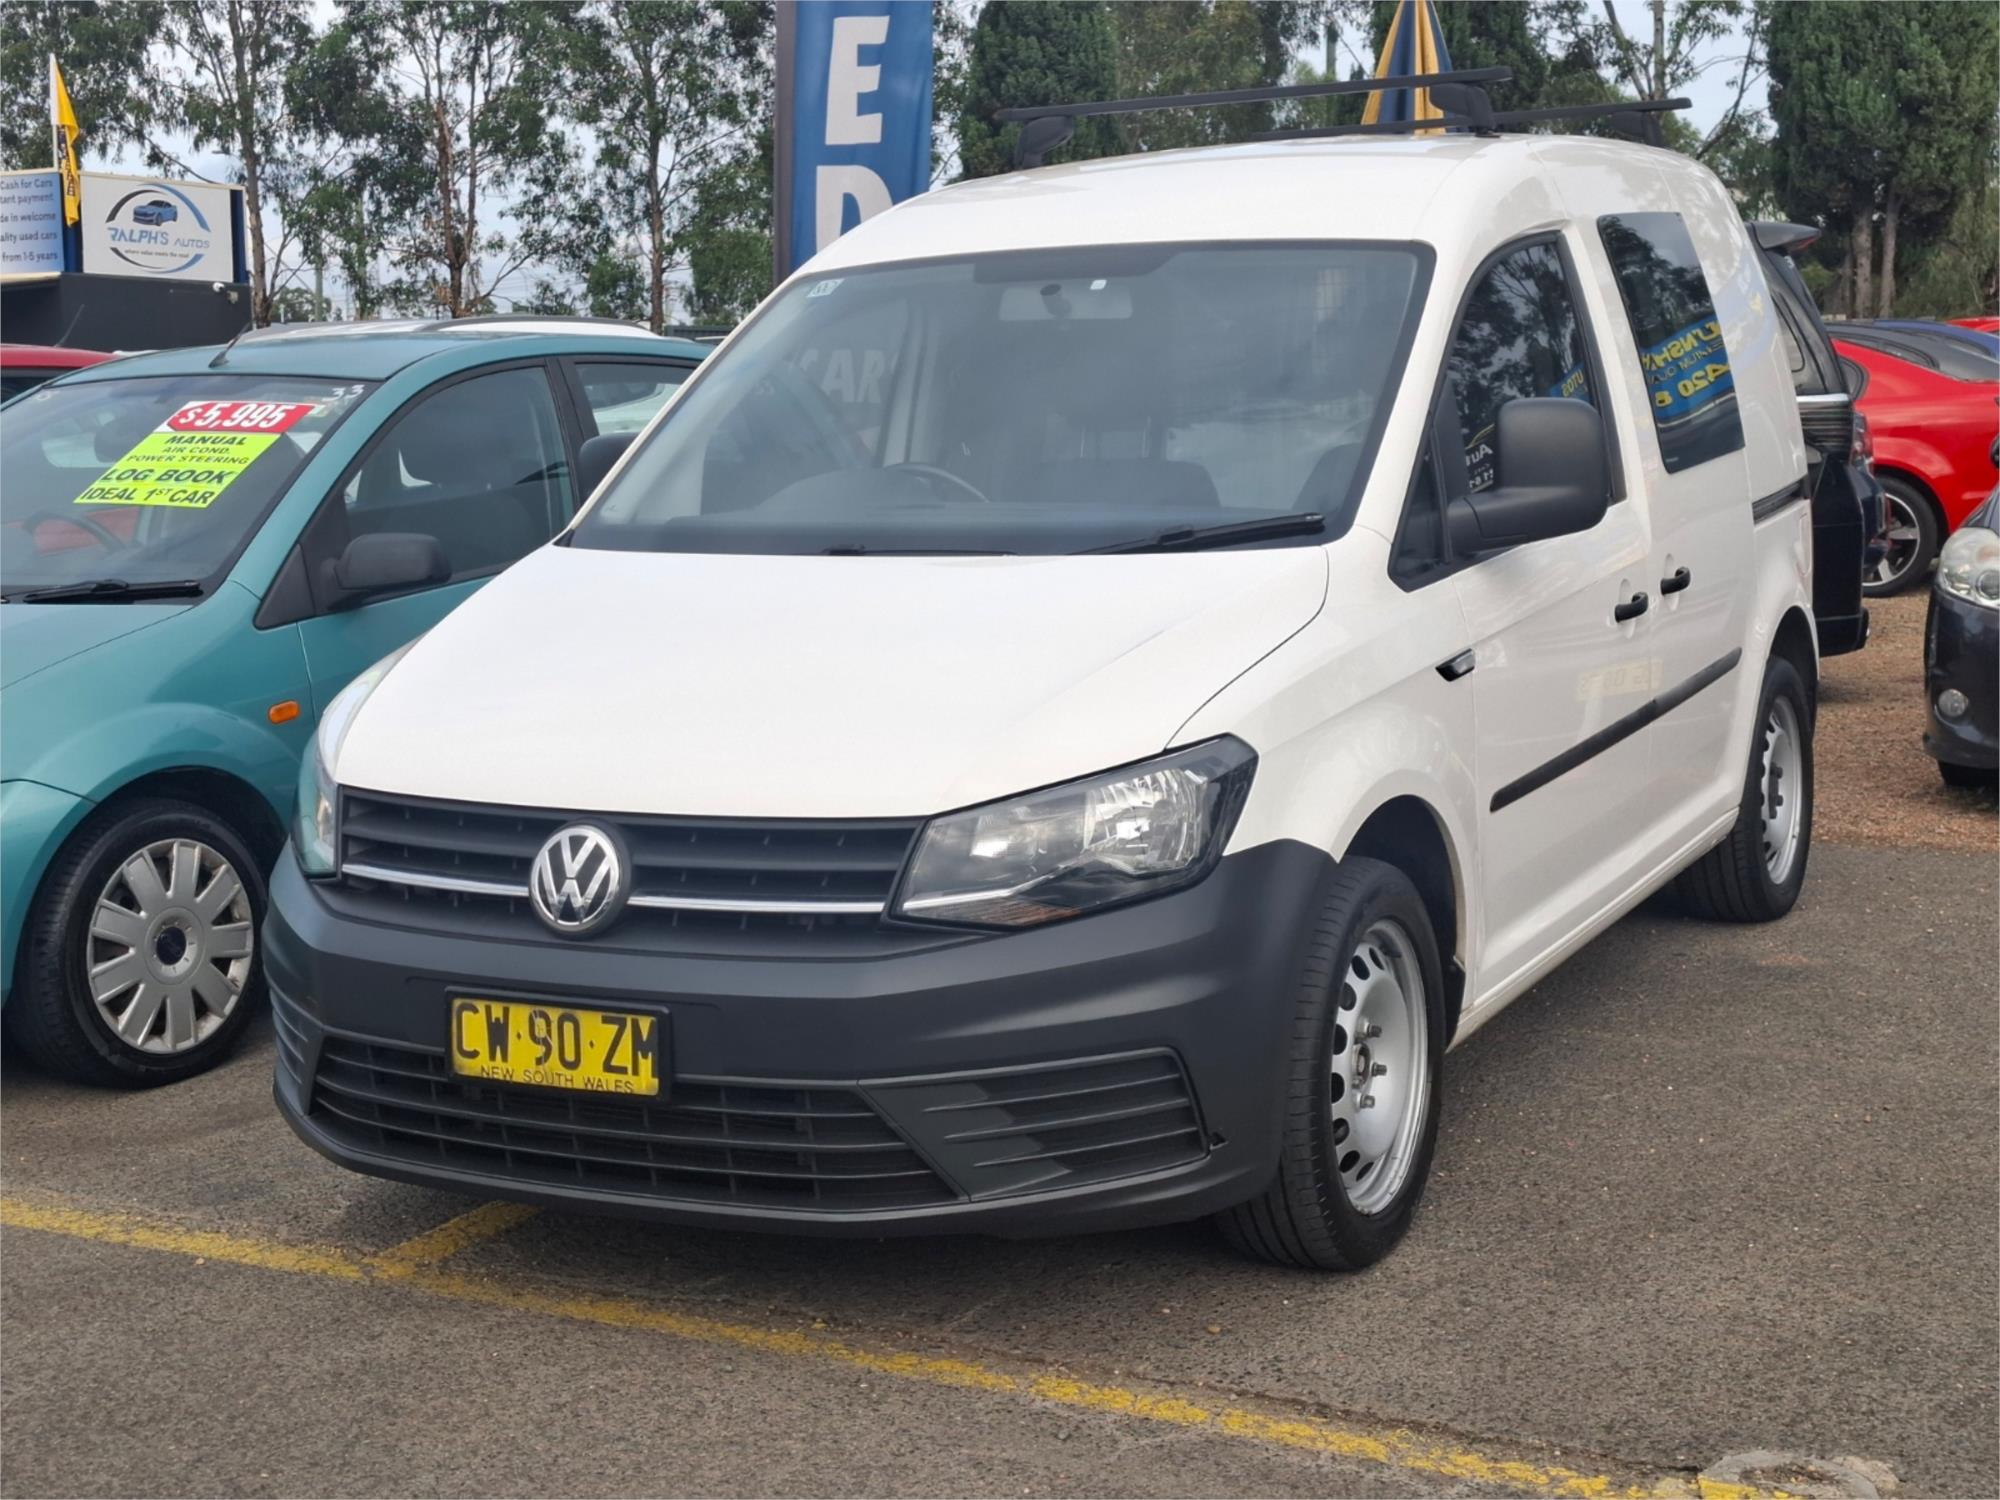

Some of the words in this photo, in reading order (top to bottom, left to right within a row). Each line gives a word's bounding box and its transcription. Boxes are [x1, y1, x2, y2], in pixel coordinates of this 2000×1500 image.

[0, 180, 20, 190] Cash
[21, 179, 33, 189] for
[34, 178, 53, 188] Cars
[18, 193, 54, 205] payment
[11, 213, 18, 222] in
[20, 211, 56, 221] welcome
[19, 231, 39, 241] used
[41, 232, 57, 241] cars
[106, 227, 169, 246] RALPH'S
[174, 237, 210, 249] AUTOS
[2, 251, 22, 261] from
[36, 251, 59, 263] years
[179, 402, 297, 428] $5,995
[163, 435, 248, 446] MANUAL
[162, 446, 187, 454] AIR
[188, 446, 231, 455] COND.
[127, 454, 176, 463] POWER
[177, 455, 251, 465] STEERING
[100, 468, 155, 482] LOG
[155, 469, 234, 484] BOOK
[81, 487, 137, 501] IDEAL
[168, 489, 216, 504] CAR
[480, 1064, 515, 1080] NEW
[522, 1068, 575, 1086] SOUTH
[581, 1075, 635, 1095] WALES
